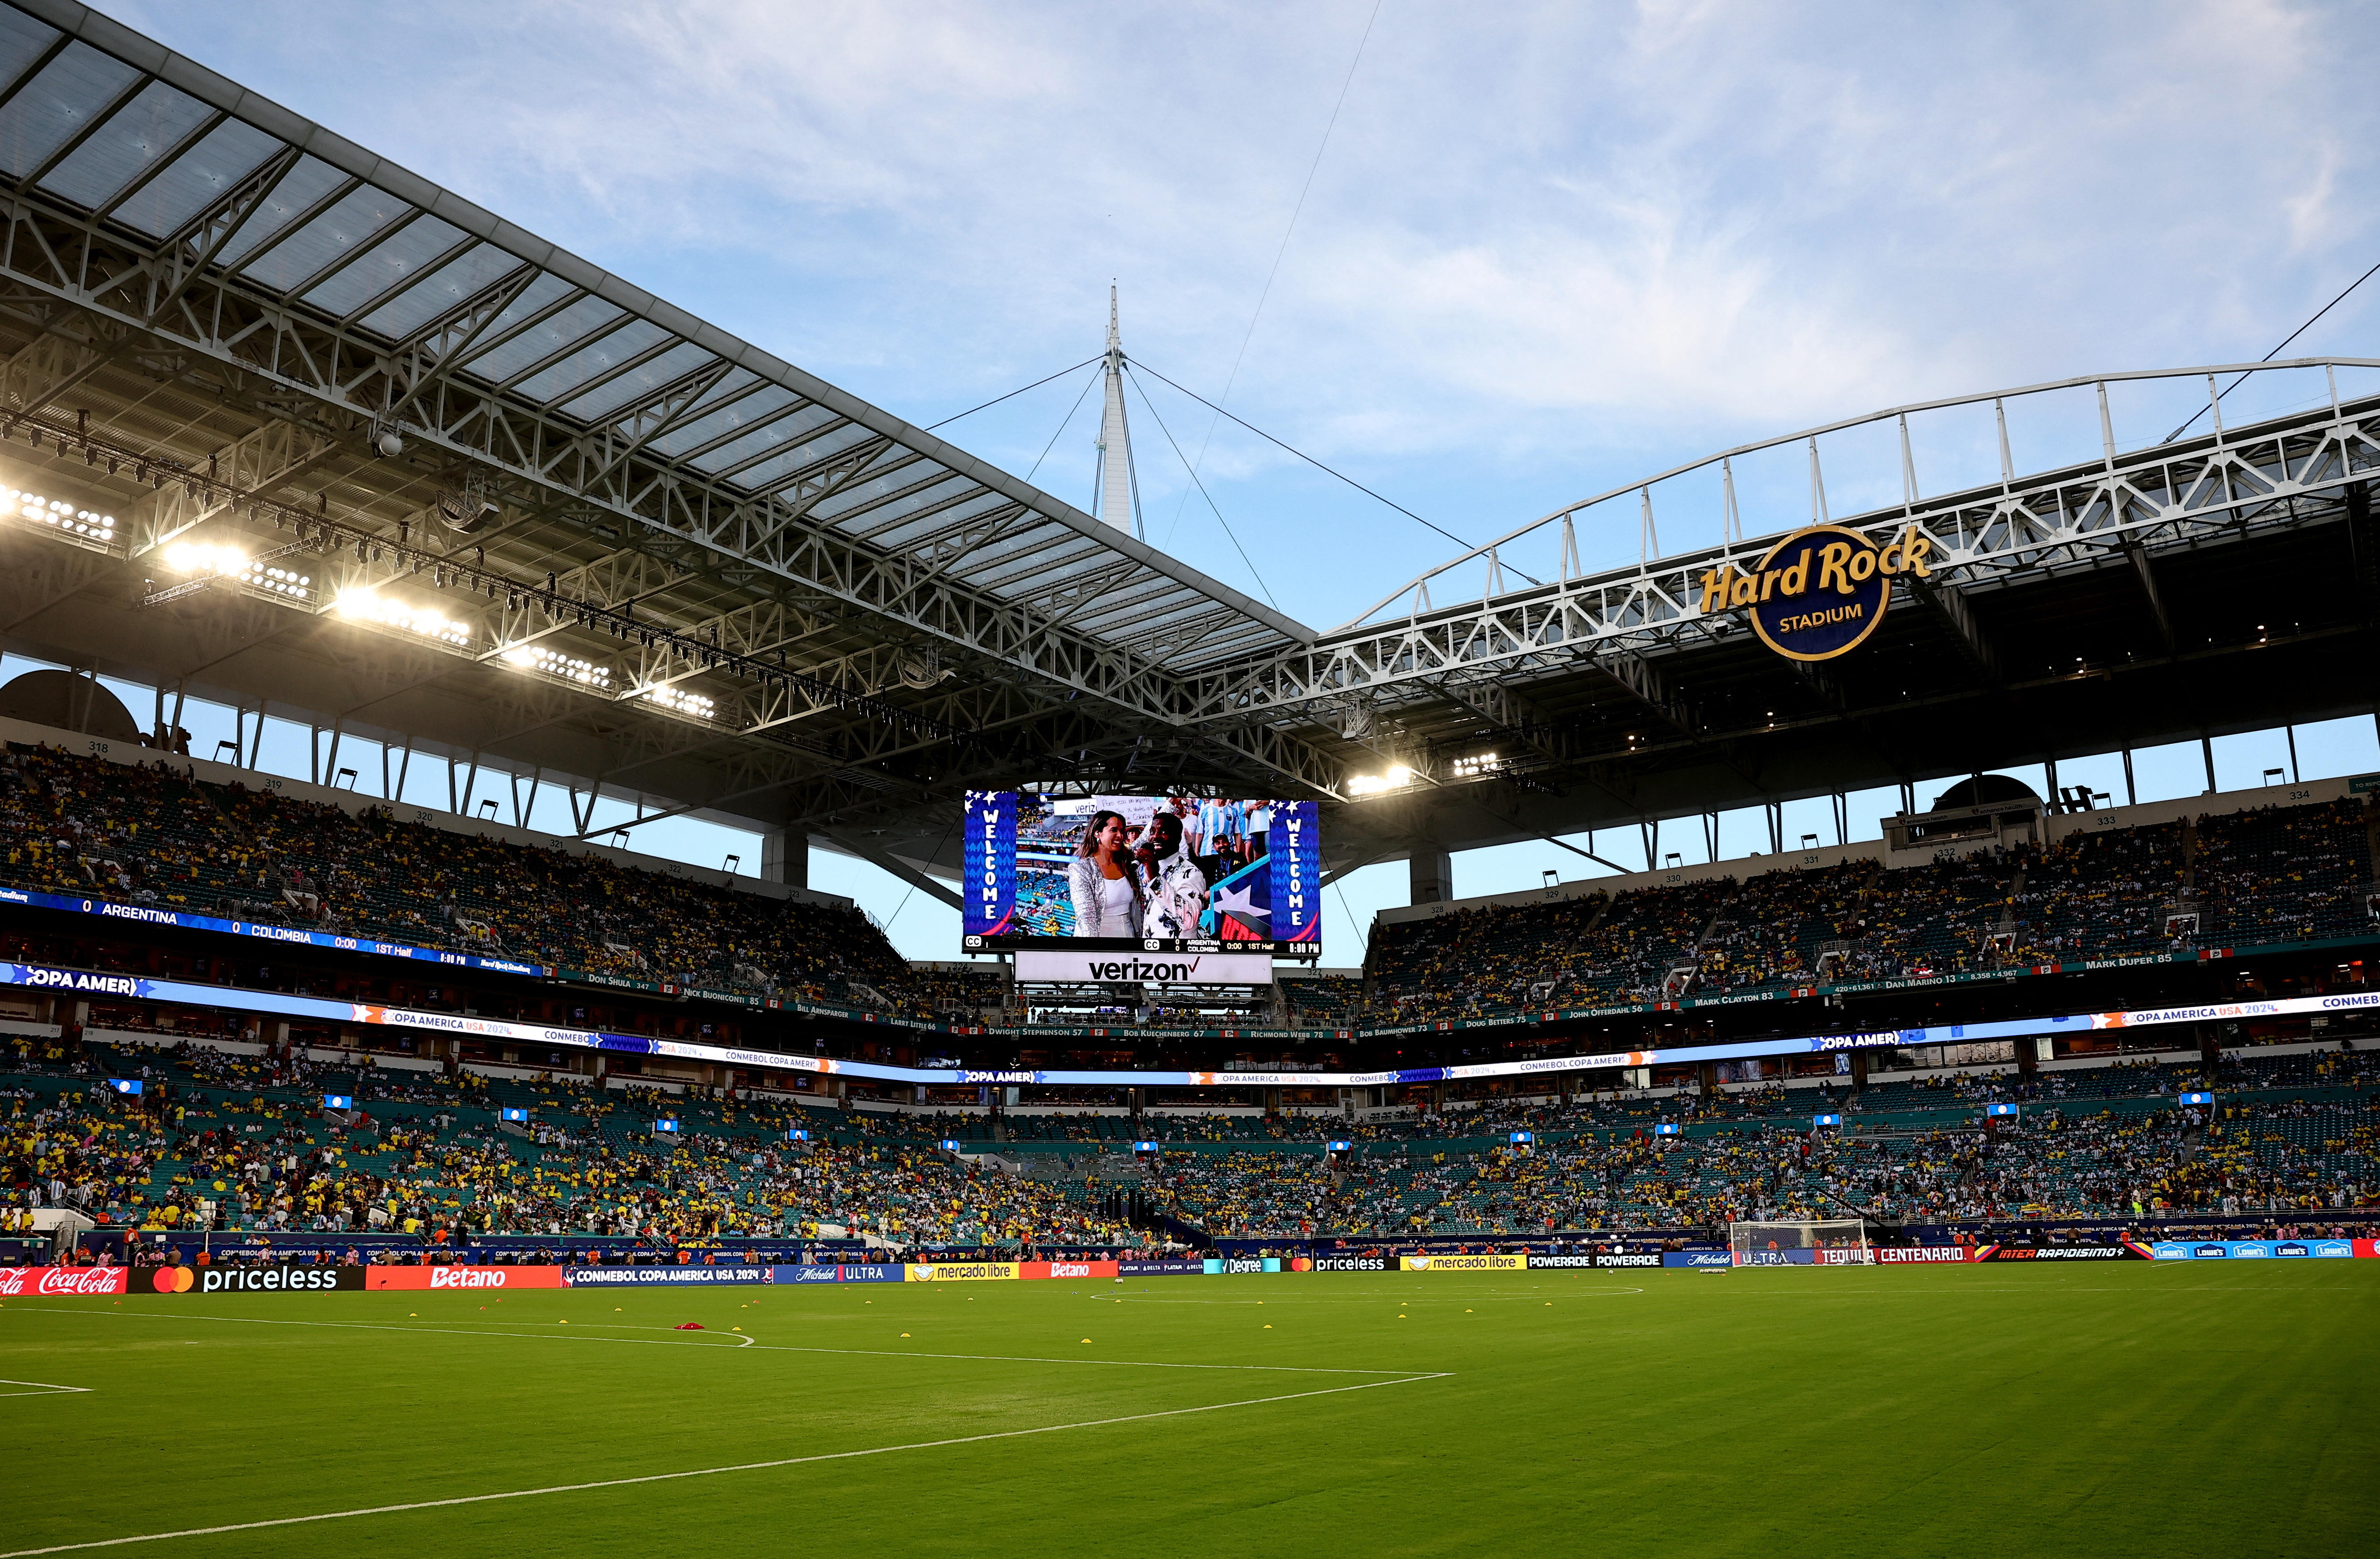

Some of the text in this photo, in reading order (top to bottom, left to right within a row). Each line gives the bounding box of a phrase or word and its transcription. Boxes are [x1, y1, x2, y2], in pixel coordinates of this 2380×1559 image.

[1700, 525, 1932, 614] Hard Rock
[1780, 603, 1862, 633] STADIUM
[89, 741, 108, 753] 318
[264, 779, 282, 789] 319
[2289, 790, 2310, 800] 334
[416, 811, 433, 822] 320
[2097, 816, 2116, 826] 333
[549, 839, 563, 848] 321
[1938, 848, 1955, 857] 332
[982, 809, 999, 920] WELCOME
[1804, 855, 1819, 864] 331
[668, 864, 681, 873] 322
[1286, 818, 1303, 926] WELCOME
[1666, 874, 1681, 882] 330
[788, 889, 800, 898] 323
[1545, 890, 1559, 899] 329
[83, 900, 177, 924] 0 ARGENTINA
[232, 922, 311, 944] 0 COLOMBIA
[335, 937, 412, 957] 0:00 1ST Half
[968, 937, 980, 946] CC
[1289, 944, 1319, 954] 8:00 PM
[441, 953, 466, 965] 8:00 PM
[2086, 954, 2172, 969] MARK DUPER 85
[480, 959, 531, 974] Hard Rock Stadium
[953, 962, 968, 971] 324
[1088, 958, 1188, 981] verizon
[1307, 969, 1322, 977] 327
[589, 974, 605, 984] DON
[608, 976, 631, 988] SHULA
[1885, 975, 1956, 989] DAN MARINO 13
[684, 988, 759, 1005] NICK BUONICONTI 85
[1695, 998, 1720, 1007] MARK
[1722, 994, 1759, 1004] CLAYTON
[797, 1004, 849, 1018] BILL ARNSPARGER
[1590, 1007, 1630, 1016] OFFERDAHL
[2163, 1008, 2217, 1020] AMERICA
[2219, 1006, 2242, 1015] USA
[2245, 1003, 2274, 1014] 2024
[418, 1015, 464, 1029] AMERICA
[466, 1021, 484, 1032] USA
[487, 1024, 509, 1034] 2024
[910, 1021, 927, 1029] LITTLE
[1488, 1018, 1514, 1026] BETTERS
[1375, 1027, 1416, 1036] BAUMHOWER
[726, 1052, 788, 1064] CONMEBOL COPA
[1520, 1058, 1592, 1071] CONMEBOL COPA
[1434, 1256, 1516, 1268] mercado libre
[1530, 1255, 1659, 1267] POWERADE POWERADE
[1687, 1253, 1787, 1265] Michelob ULTRA
[1822, 1247, 1964, 1264] TEQUILA CENTENARIO
[1051, 1262, 1089, 1277] Betano
[1230, 1259, 1261, 1273] Degree
[1316, 1257, 1384, 1271] priceless
[430, 1267, 506, 1287] Betano
[577, 1269, 759, 1283] CONMEBOL COPA AMERICA USA 2024
[796, 1267, 883, 1281] Michelob ULTRA
[938, 1264, 1010, 1278] mercado libre
[38, 1267, 124, 1294] Coca-Cola
[203, 1265, 337, 1293] priceless
